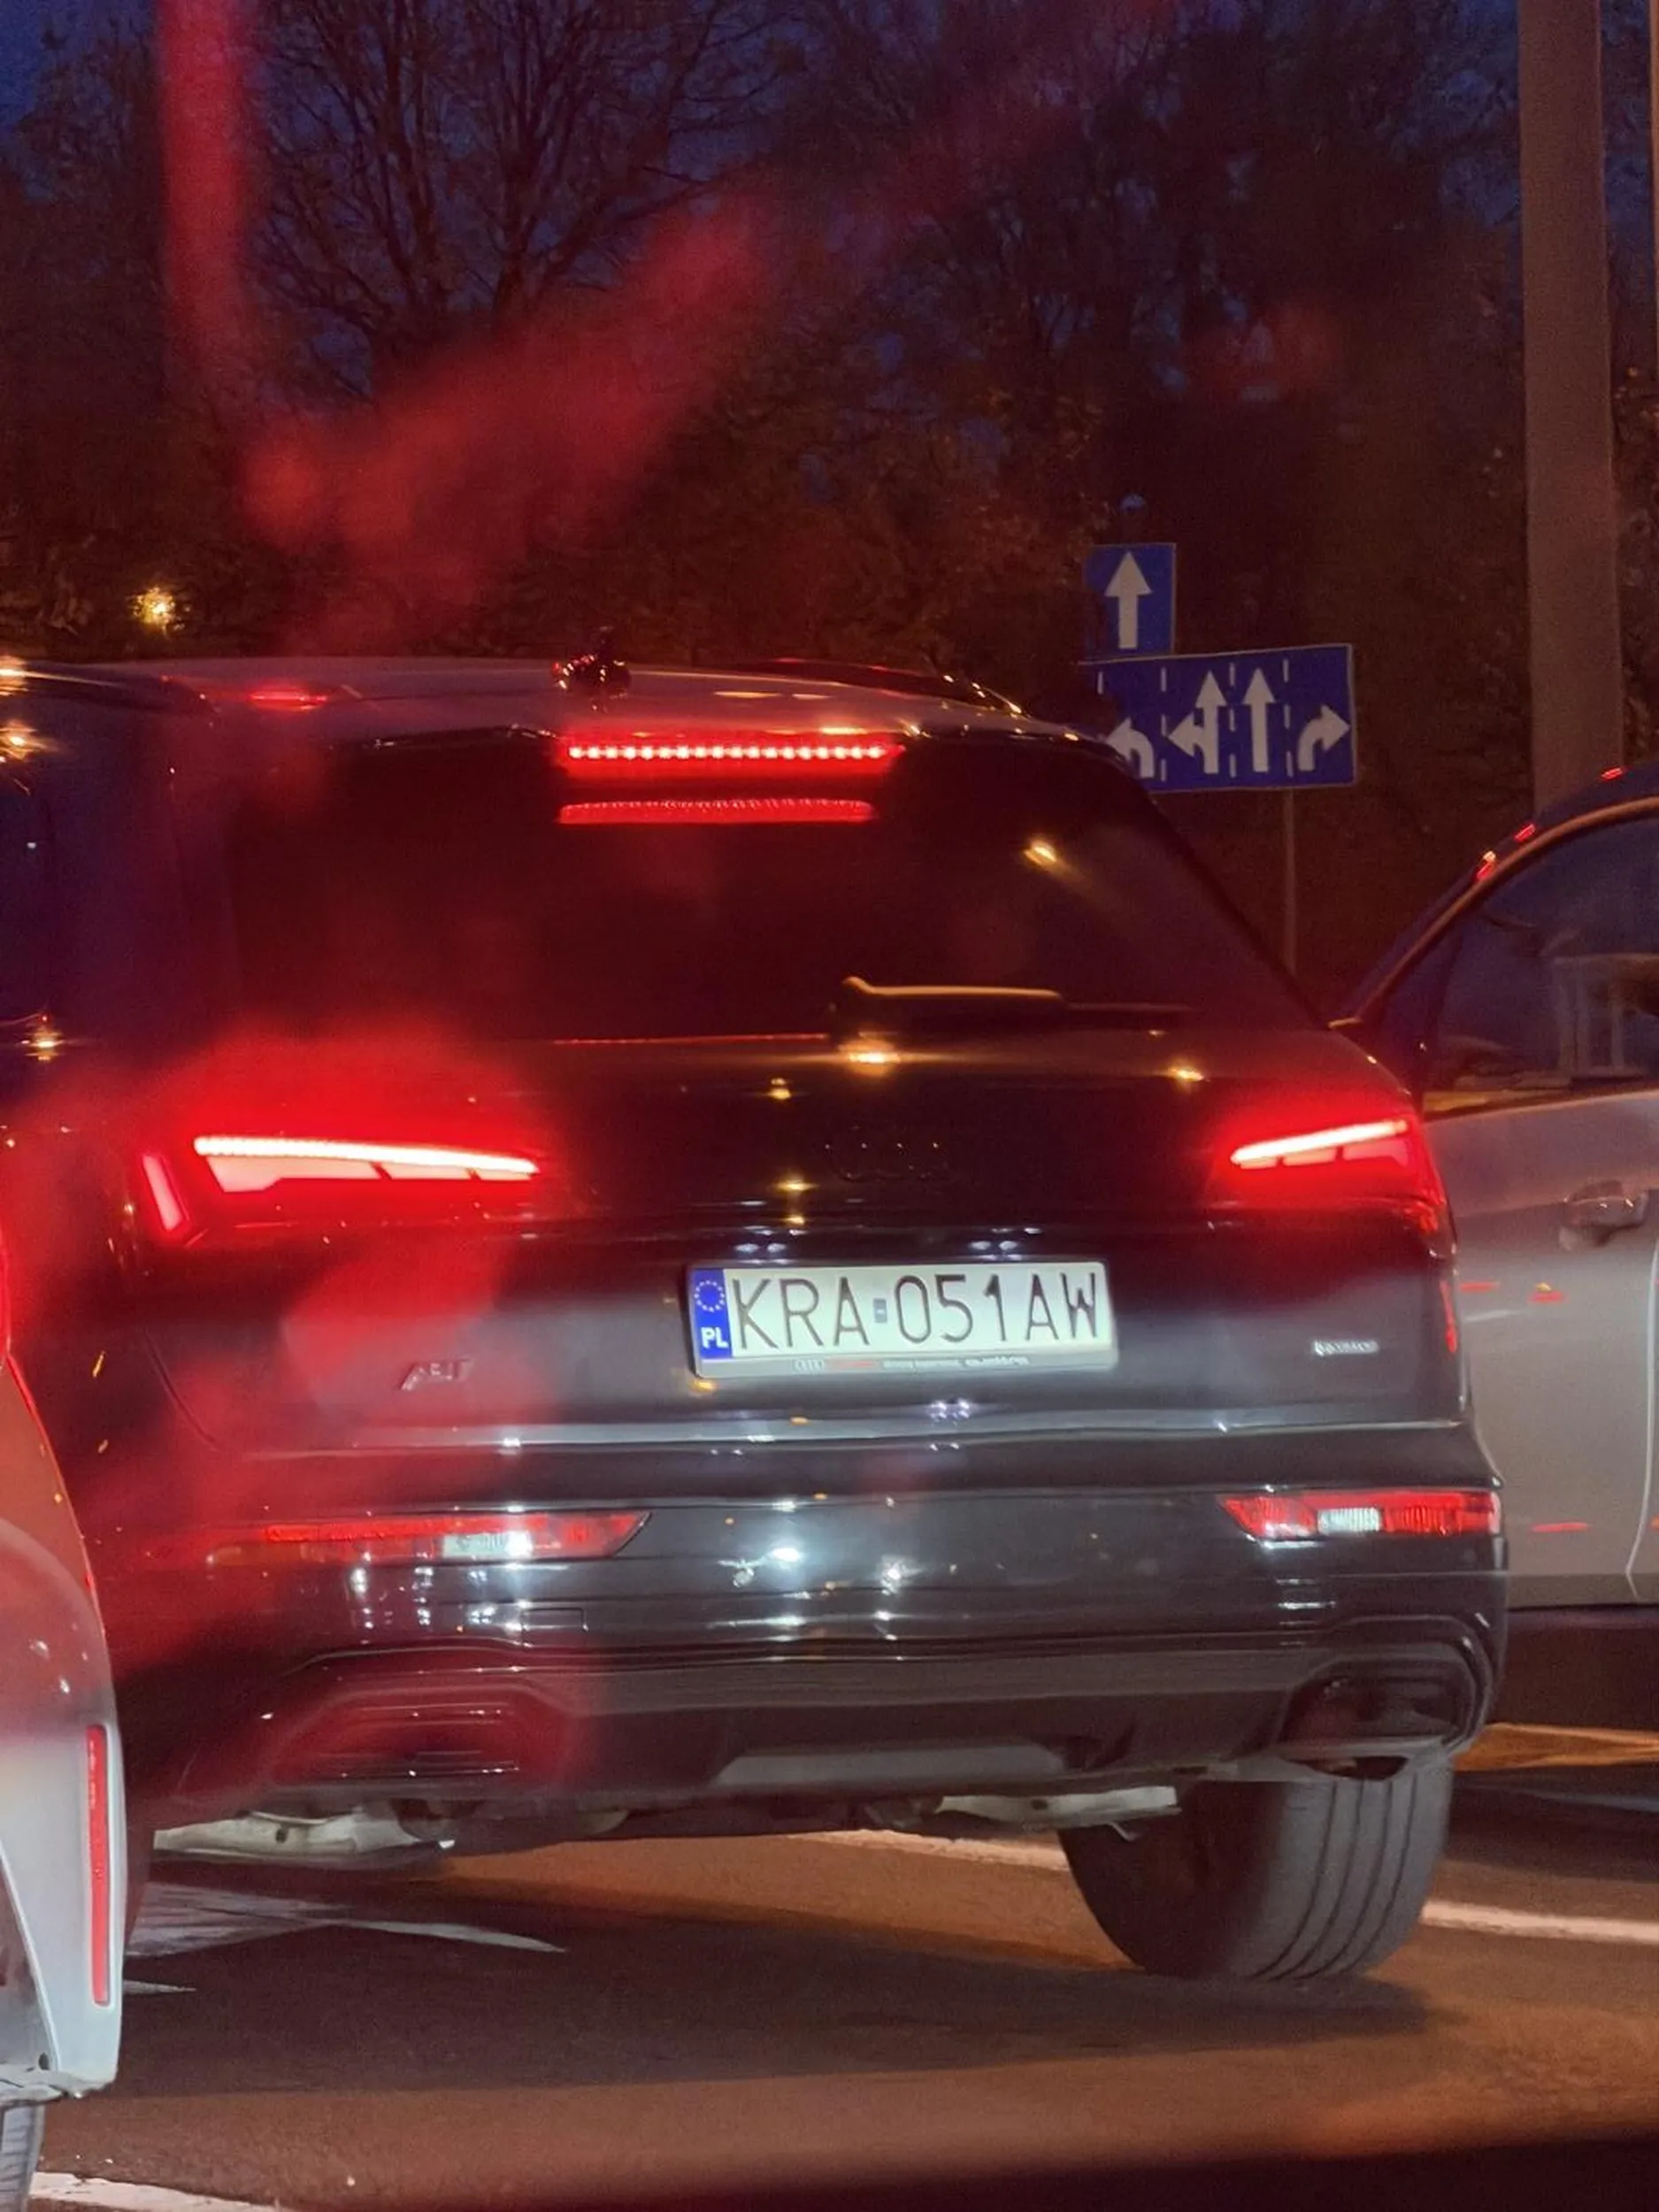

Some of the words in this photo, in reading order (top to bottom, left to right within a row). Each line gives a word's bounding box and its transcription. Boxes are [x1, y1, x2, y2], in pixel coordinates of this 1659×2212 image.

[732, 1276, 871, 1349] KRA
[894, 1271, 1099, 1343] 051AW
[701, 1327, 728, 1348] PL
